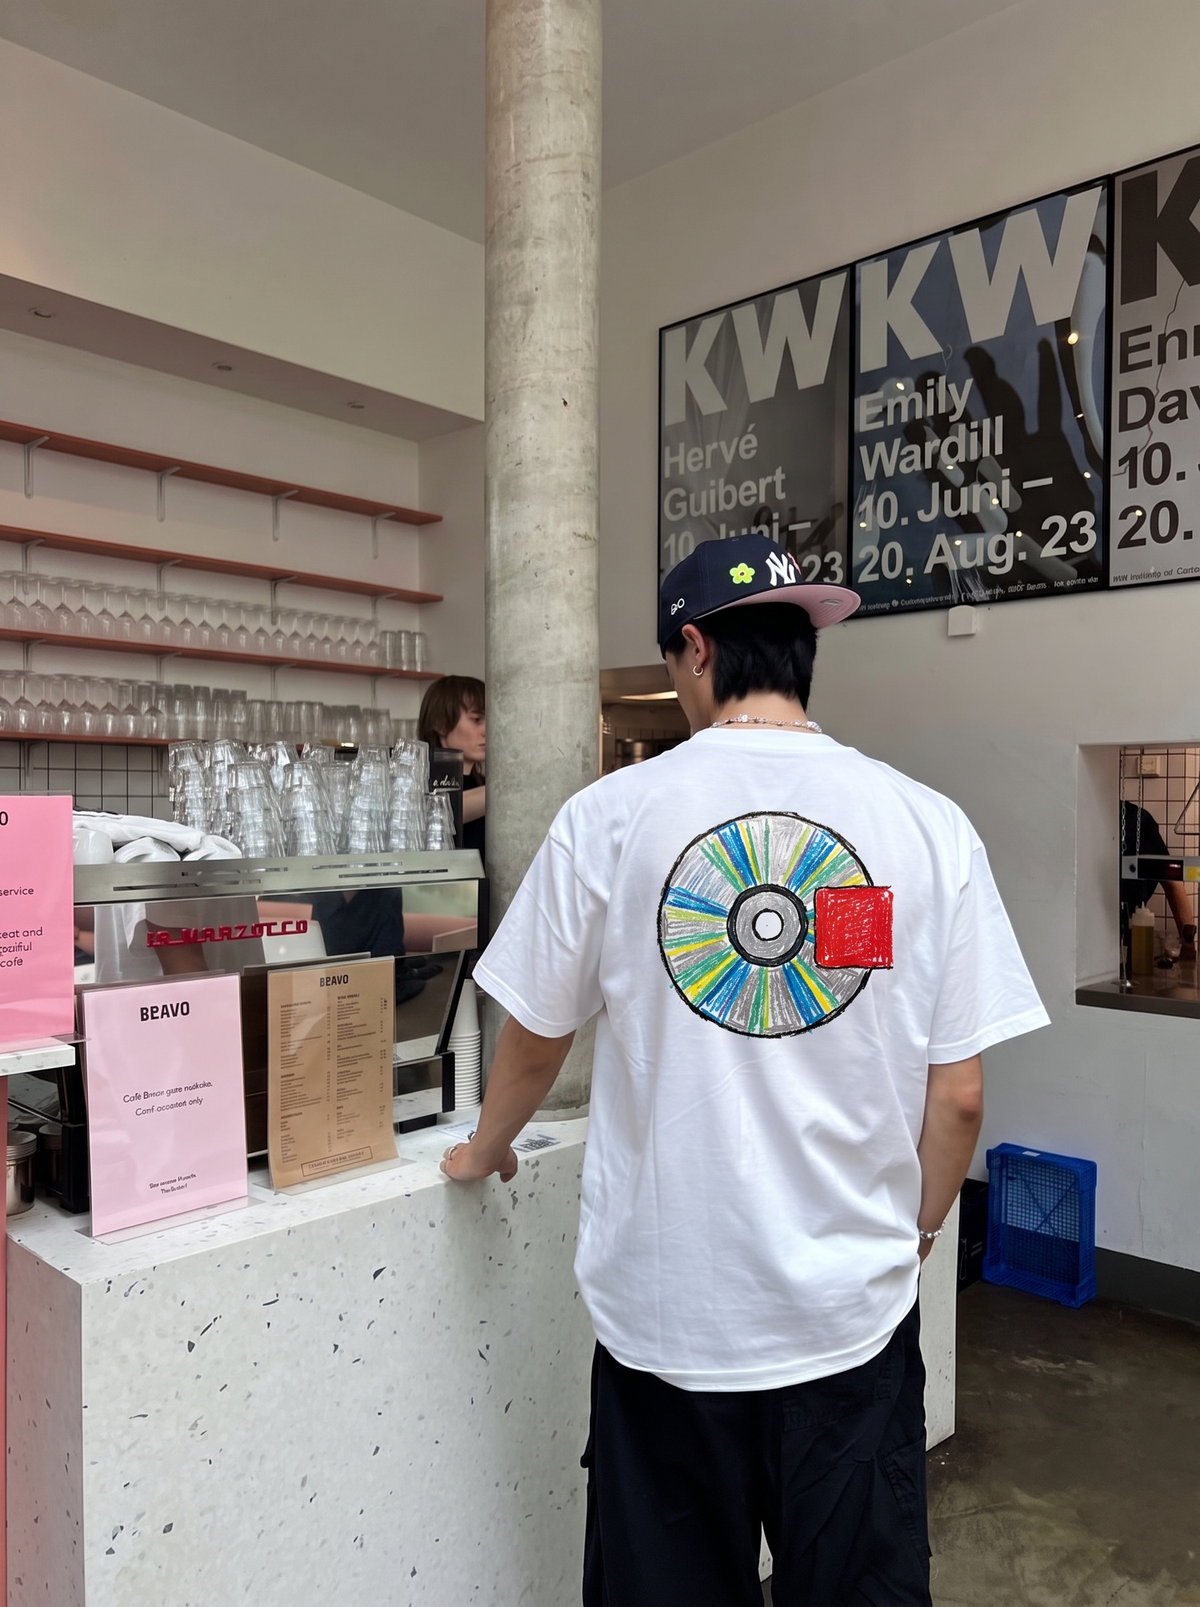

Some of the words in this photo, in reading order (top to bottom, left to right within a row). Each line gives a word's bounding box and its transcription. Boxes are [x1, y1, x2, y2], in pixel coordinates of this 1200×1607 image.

[860, 185, 1103, 374] KW
[664, 270, 849, 426] KW
[1119, 324, 1200, 375] En
[859, 375, 974, 433] Emily
[664, 423, 758, 479] Hervé
[859, 415, 1004, 482] Wardill
[1118, 441, 1187, 490] 10.
[663, 466, 786, 521] Guibert
[858, 491, 909, 532] 10.
[917, 468, 1011, 523] Juni
[857, 541, 914, 584] 20.
[923, 531, 1027, 575] Aug.
[1039, 510, 1097, 558] 23
[1117, 500, 1194, 550] 20.
[802, 551, 844, 585] 23
[22, 926, 43, 938] and
